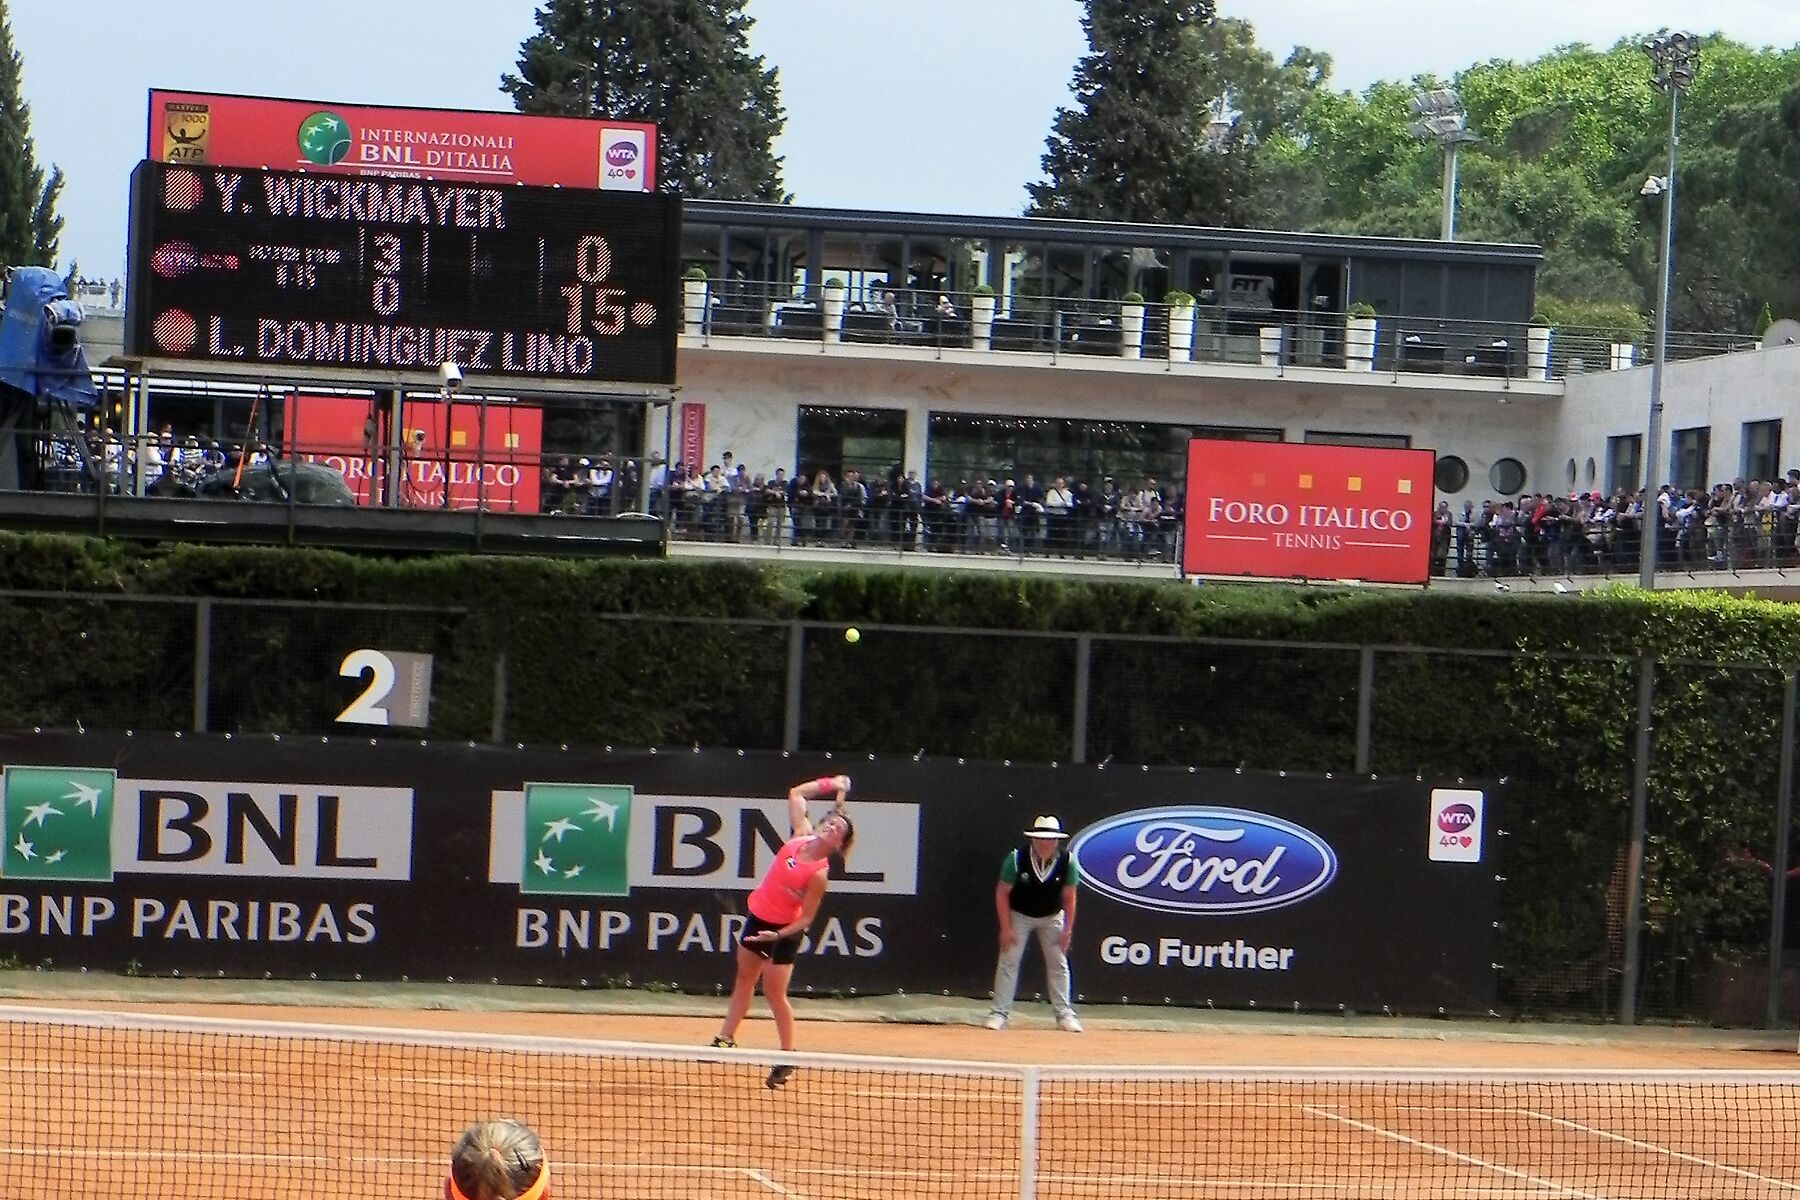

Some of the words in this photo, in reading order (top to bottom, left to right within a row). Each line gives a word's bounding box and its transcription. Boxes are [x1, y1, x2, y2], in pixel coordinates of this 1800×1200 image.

[169, 147, 204, 158] ATP
[360, 128, 513, 149] INTERNAZIONALI
[608, 149, 636, 159] WTA
[360, 143, 421, 165] BNL
[426, 150, 513, 170] D'ITALIA
[360, 169, 380, 177] BNP
[214, 173, 252, 214] Y.
[263, 175, 506, 230] WICKMAYER
[373, 232, 401, 275] 3
[576, 235, 612, 285] 0
[1231, 277, 1262, 291] FIT
[372, 276, 399, 315] 0
[560, 283, 627, 336] 15
[208, 315, 245, 356] L.
[257, 318, 494, 369] DOMINGUEZ
[502, 331, 593, 374] LINO
[1208, 497, 1290, 525] FORO
[1298, 505, 1412, 532] ITALICO
[1272, 532, 1341, 550] TENNIS
[335, 648, 396, 726] 2
[137, 789, 379, 869] BNL
[1440, 812, 1472, 824] WTA
[1116, 821, 1287, 896] Ford
[0, 893, 116, 936] BNP
[132, 898, 377, 944] PARIBAS
[516, 908, 632, 950] BNP
[647, 911, 885, 958] PARAS
[1100, 935, 1151, 965] Go
[1158, 938, 1294, 970] Further
